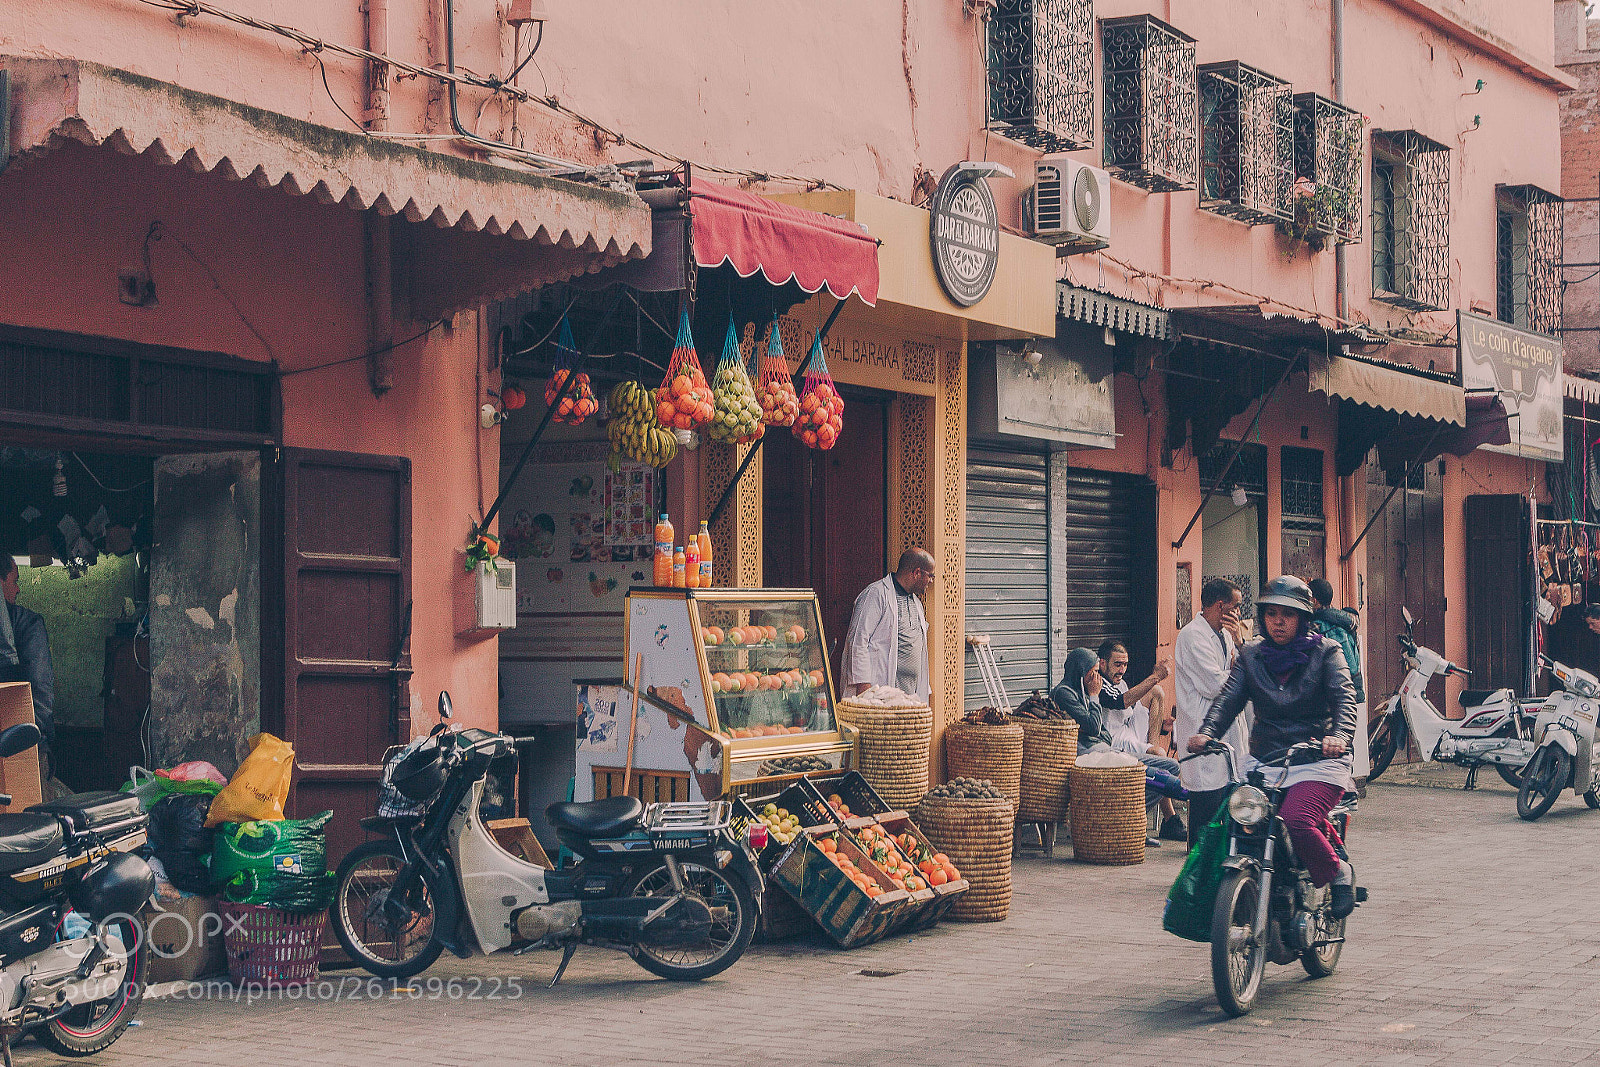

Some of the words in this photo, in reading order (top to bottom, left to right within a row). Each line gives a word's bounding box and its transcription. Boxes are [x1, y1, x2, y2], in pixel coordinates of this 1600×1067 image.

[938, 213, 955, 241] DAR
[963, 220, 997, 252] BARAKA
[1472, 324, 1486, 348] Le
[1488, 332, 1510, 354] coin
[1512, 336, 1553, 366] d'argane
[653, 839, 690, 849] YAMAHA
